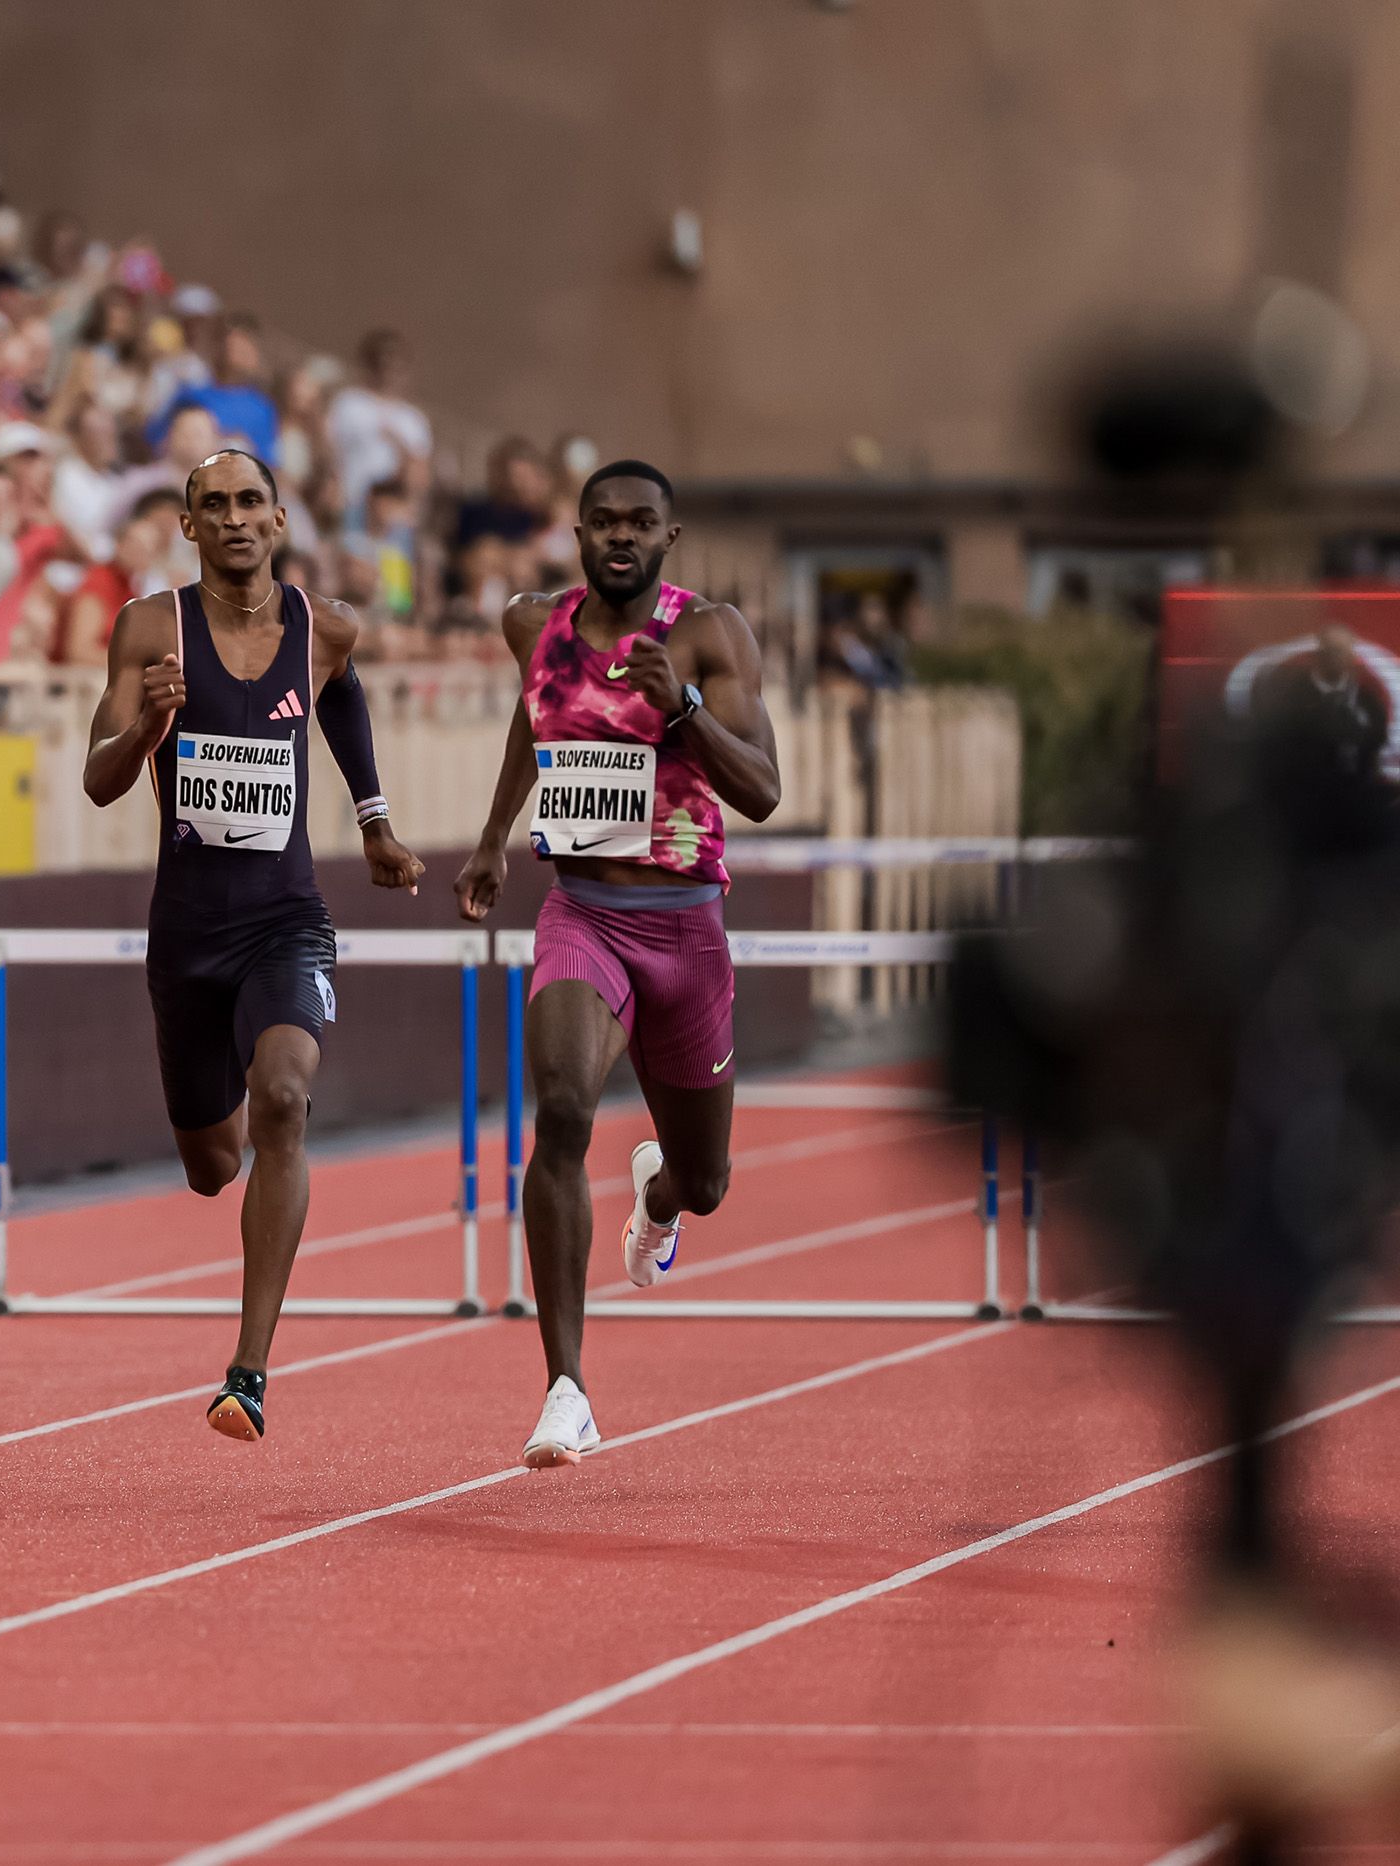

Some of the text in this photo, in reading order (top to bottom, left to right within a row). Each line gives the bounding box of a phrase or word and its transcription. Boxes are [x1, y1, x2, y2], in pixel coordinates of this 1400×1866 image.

[200, 742, 291, 766] SLOVENIJALES
[556, 750, 646, 771] SLOVENIJALES
[179, 776, 292, 817] DOS SANTOS
[538, 786, 647, 823] BENJAMIN
